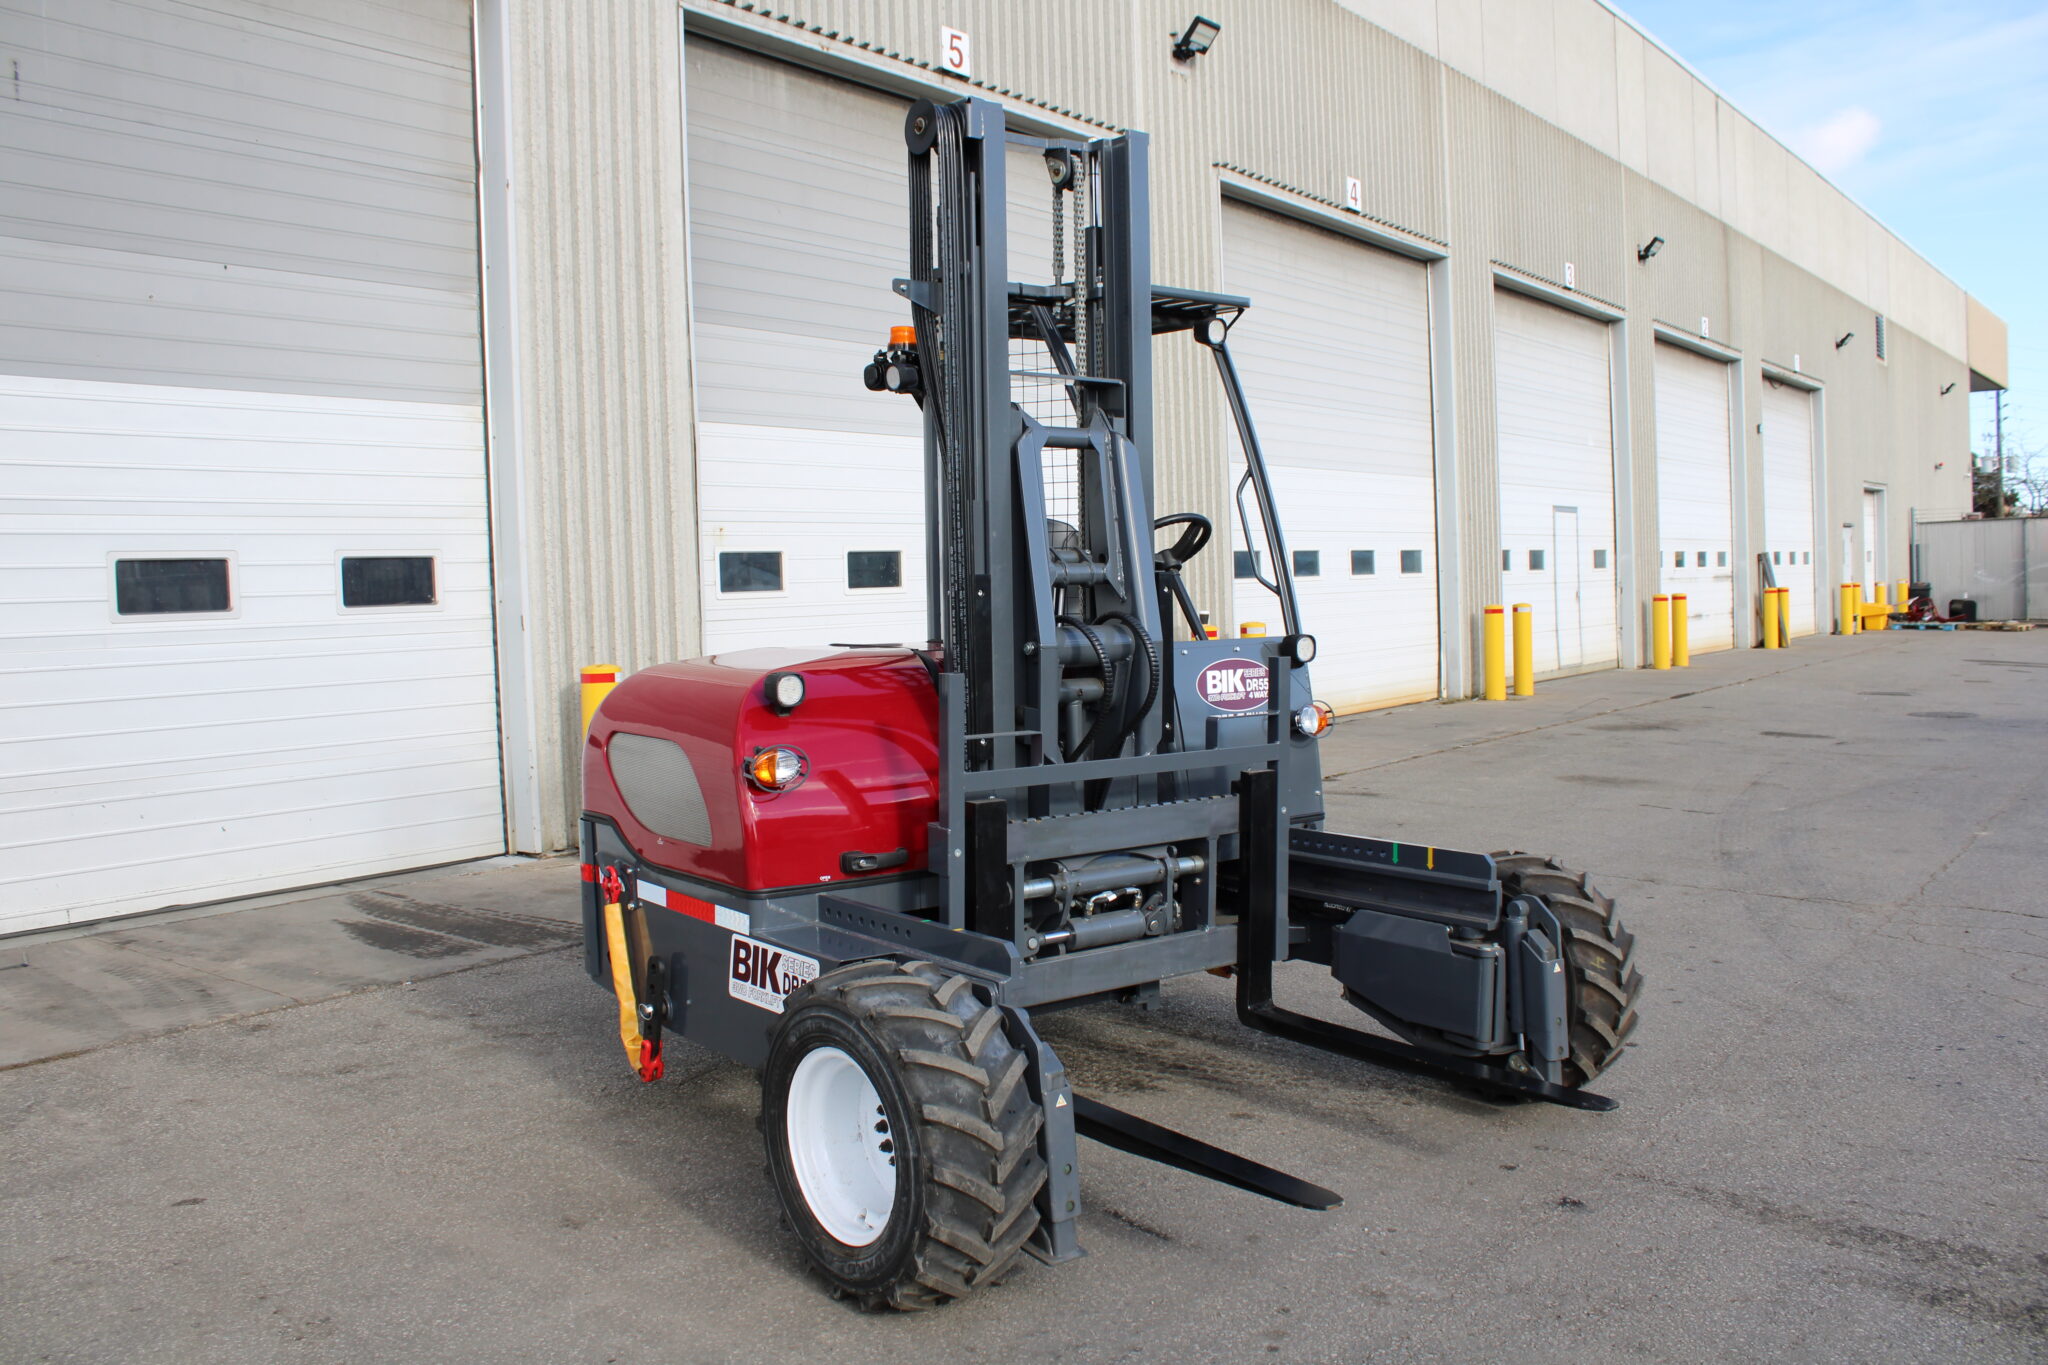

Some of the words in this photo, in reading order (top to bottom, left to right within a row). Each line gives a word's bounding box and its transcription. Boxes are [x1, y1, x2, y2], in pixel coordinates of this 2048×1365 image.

[949, 33, 963, 68] 5
[1350, 181, 1358, 206] 4
[1567, 265, 1573, 285] 3
[1206, 669, 1245, 694] BIK
[1246, 678, 1268, 691] DR55
[732, 939, 782, 995] BIK
[782, 955, 816, 979] SERIES
